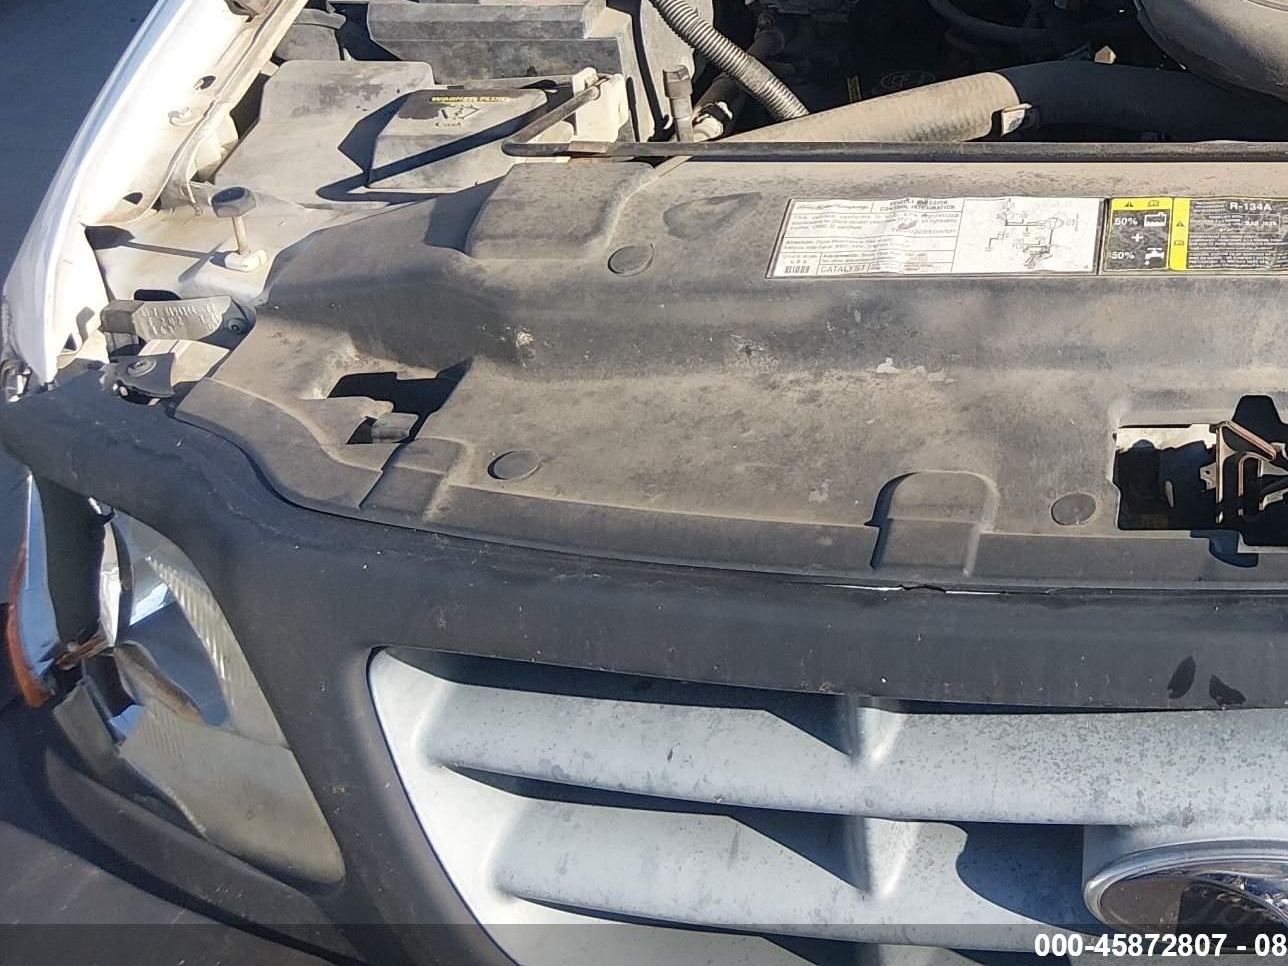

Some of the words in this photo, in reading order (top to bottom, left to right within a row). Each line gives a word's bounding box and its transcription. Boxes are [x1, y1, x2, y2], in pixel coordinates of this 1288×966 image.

[1229, 201, 1273, 211] R-134A
[1114, 217, 1138, 226] 50%
[1111, 251, 1136, 260] 50%
[820, 264, 867, 274] CATALYST
